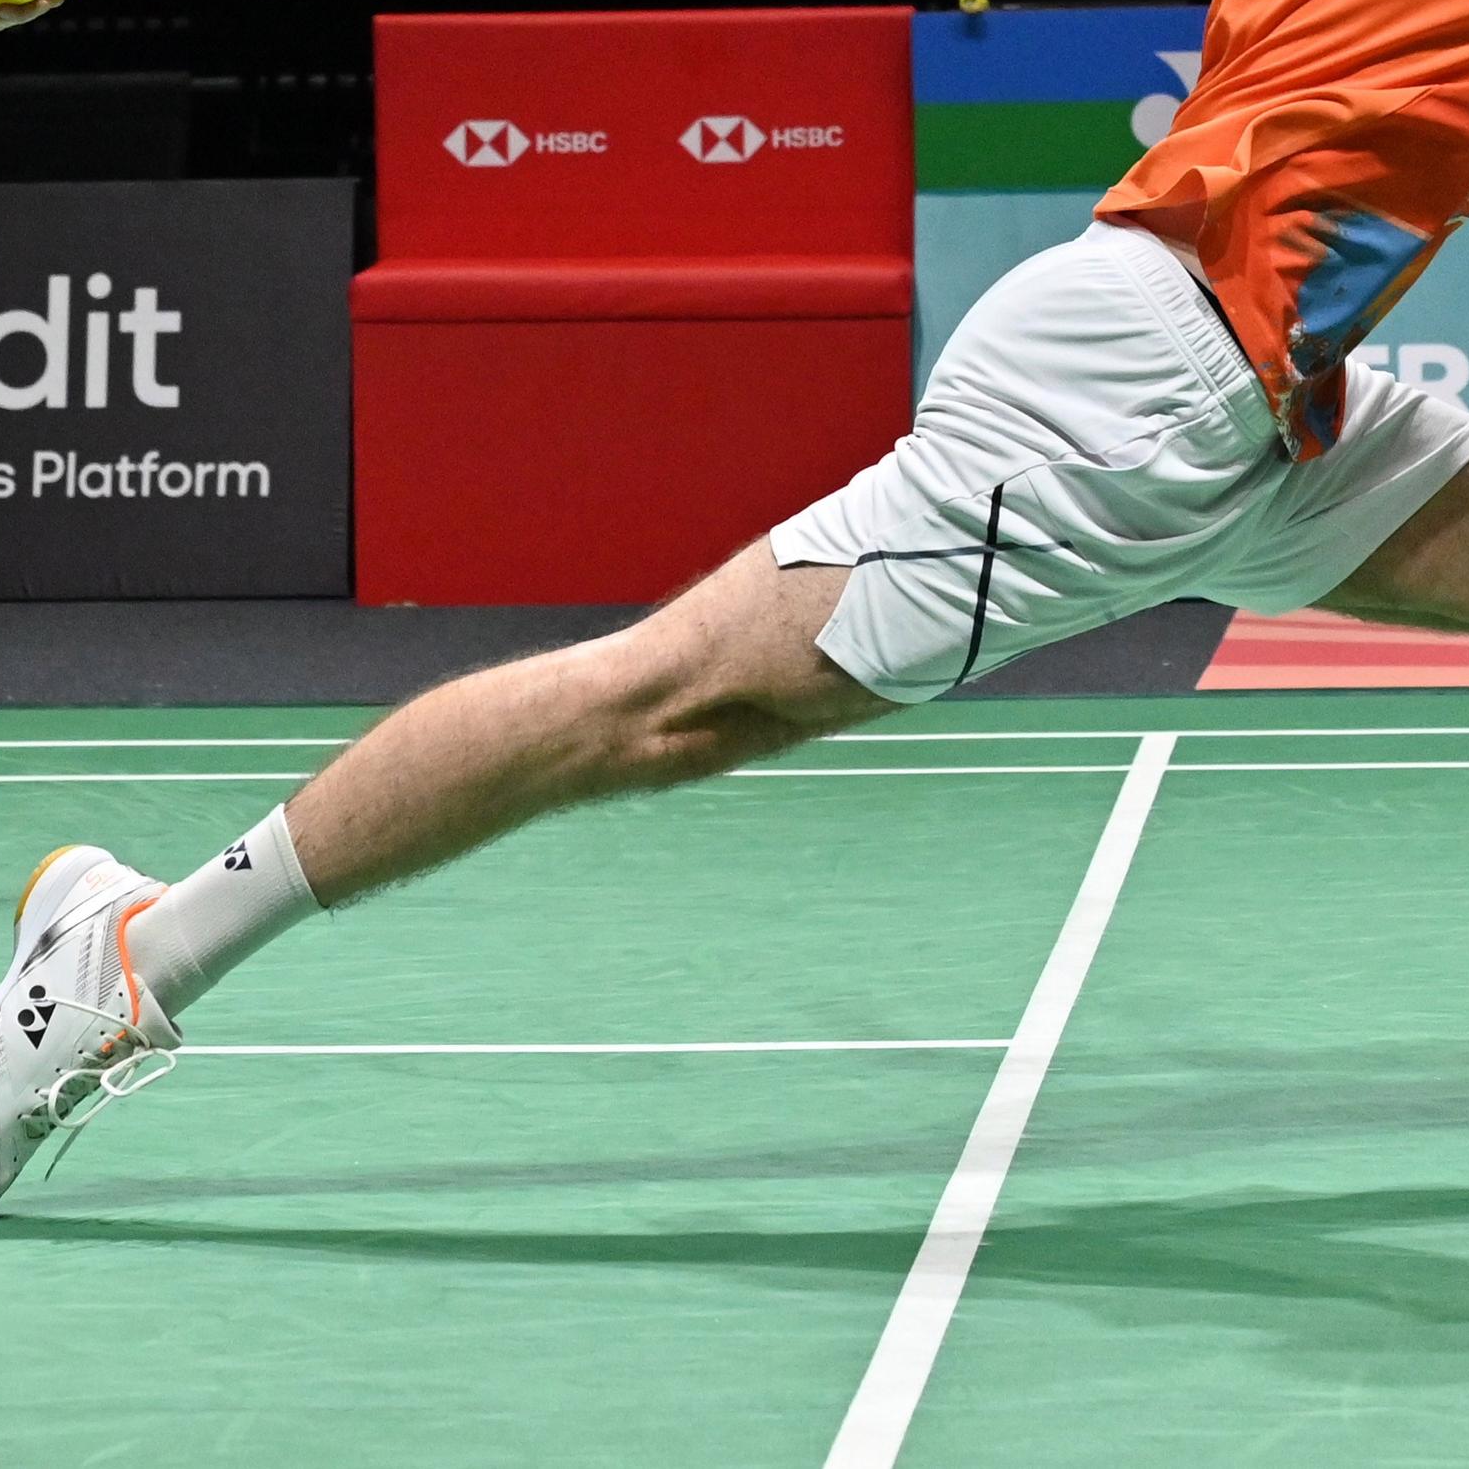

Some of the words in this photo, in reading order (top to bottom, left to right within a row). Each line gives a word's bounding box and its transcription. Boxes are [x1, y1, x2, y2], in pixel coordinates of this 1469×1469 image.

[535, 131, 608, 153] HSBC
[771, 126, 844, 148] HSBC
[32, 448, 271, 500] Platform
